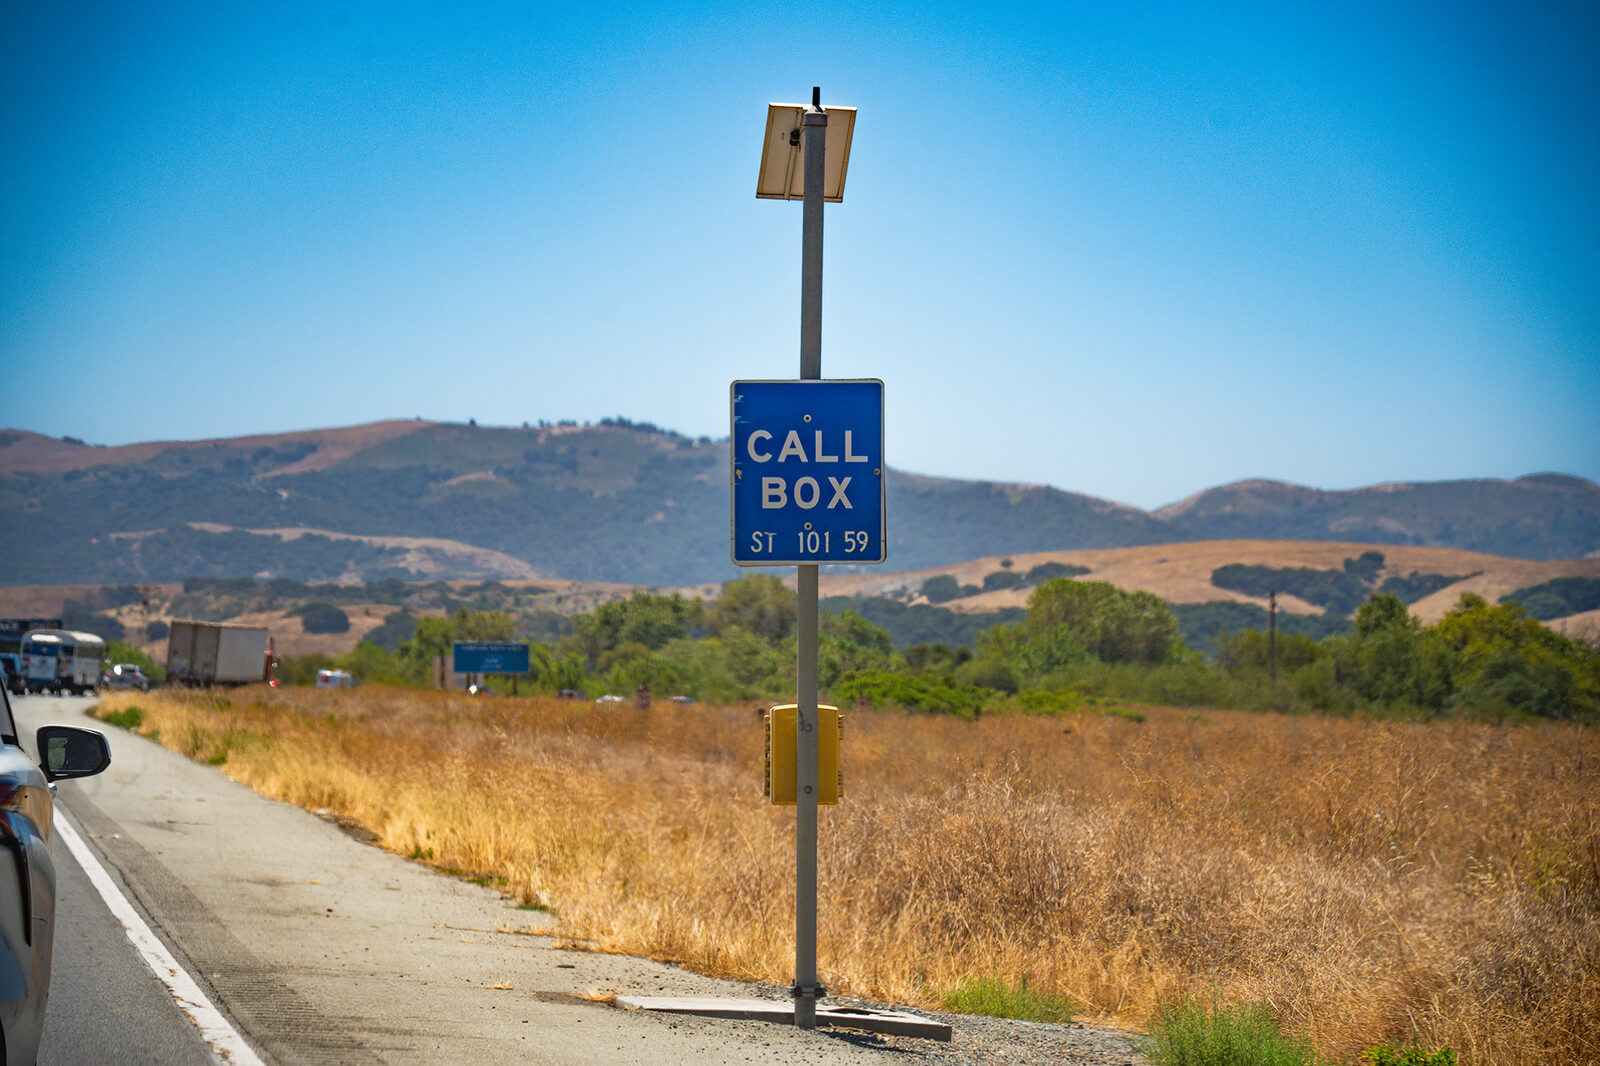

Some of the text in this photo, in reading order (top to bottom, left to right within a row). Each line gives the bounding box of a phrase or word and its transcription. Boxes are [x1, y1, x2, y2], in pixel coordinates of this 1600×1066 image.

[747, 430, 868, 463] CALL
[761, 476, 853, 509] BOX
[750, 531, 869, 553] ST 101 59
